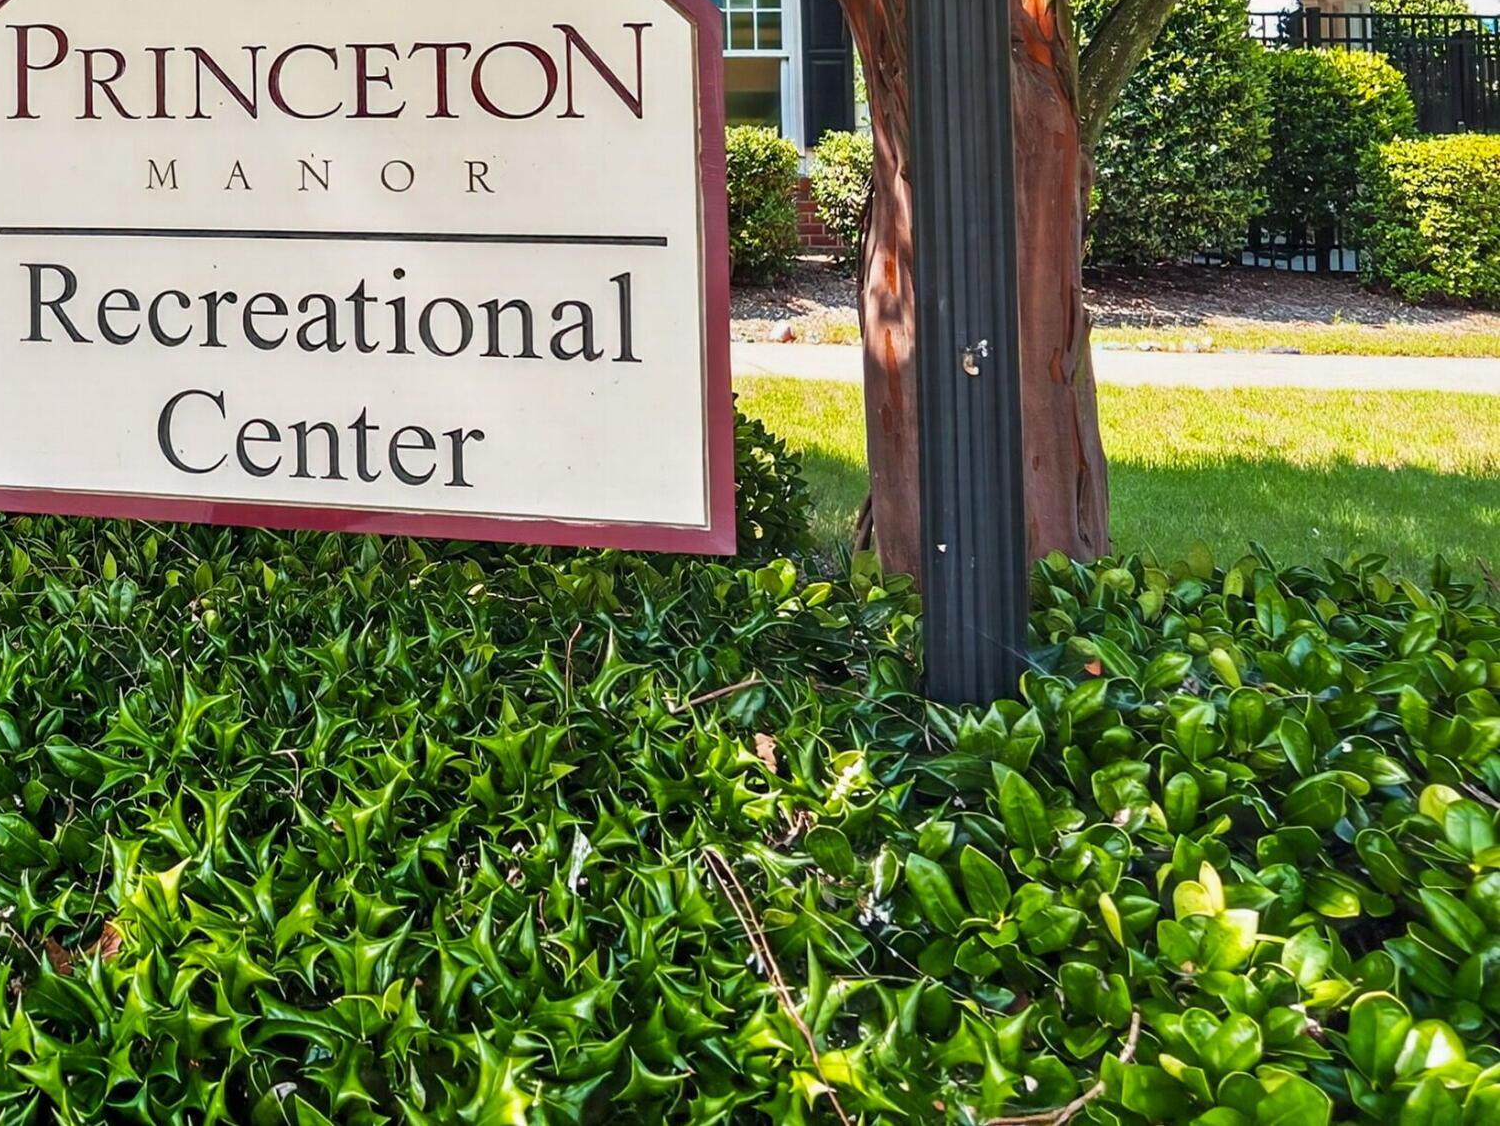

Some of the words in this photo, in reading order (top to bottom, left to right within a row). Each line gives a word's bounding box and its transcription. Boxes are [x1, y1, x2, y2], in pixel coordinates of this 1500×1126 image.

[5, 22, 653, 120] PRINCETON
[146, 159, 495, 194] MANOR
[19, 262, 643, 363] Recreational
[157, 389, 486, 488] Center
